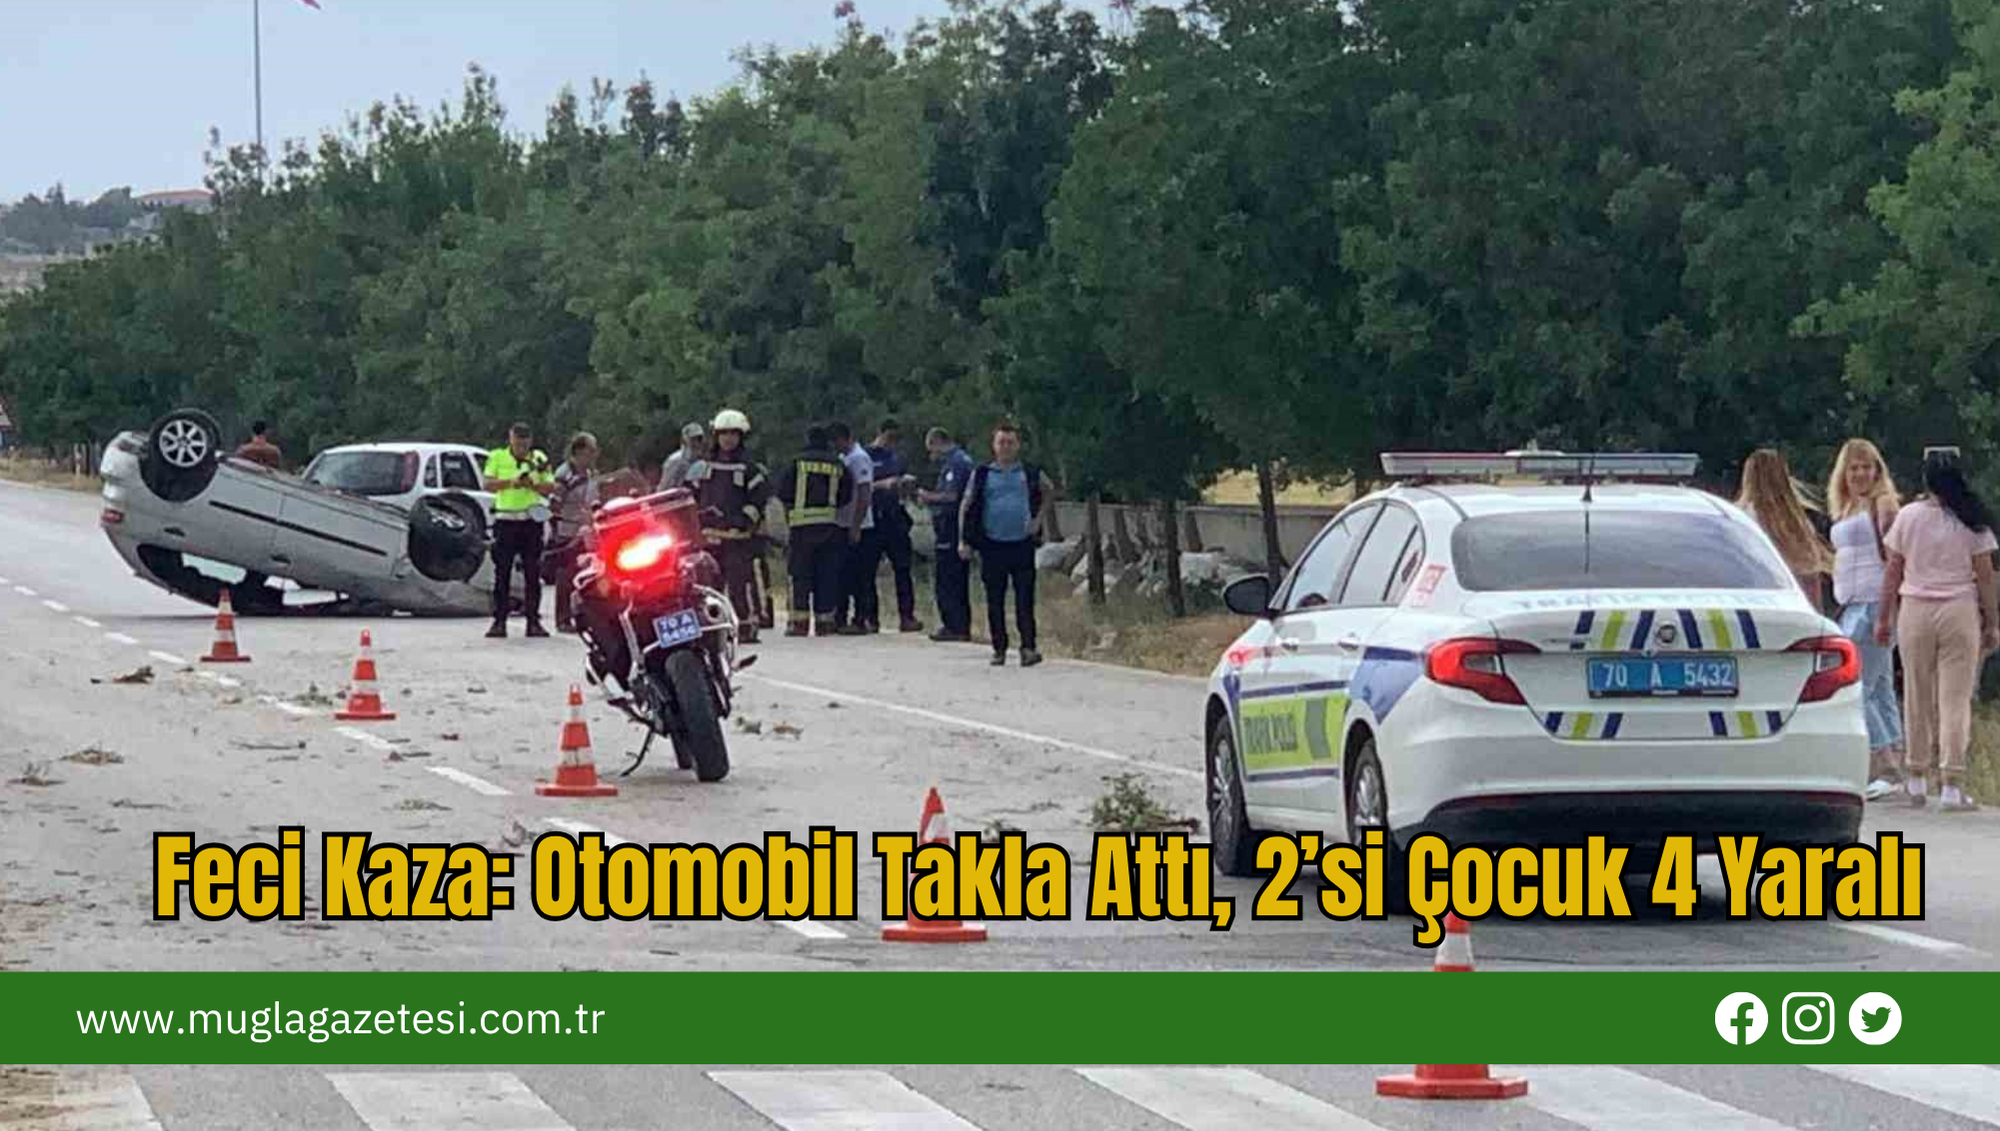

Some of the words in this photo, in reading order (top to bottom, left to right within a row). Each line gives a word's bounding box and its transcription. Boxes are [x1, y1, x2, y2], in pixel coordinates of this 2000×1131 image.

[660, 617, 678, 630] 70
[681, 613, 692, 625] A
[1602, 663, 1628, 687] 70
[1651, 662, 1663, 687] A
[1683, 662, 1734, 687] 5432
